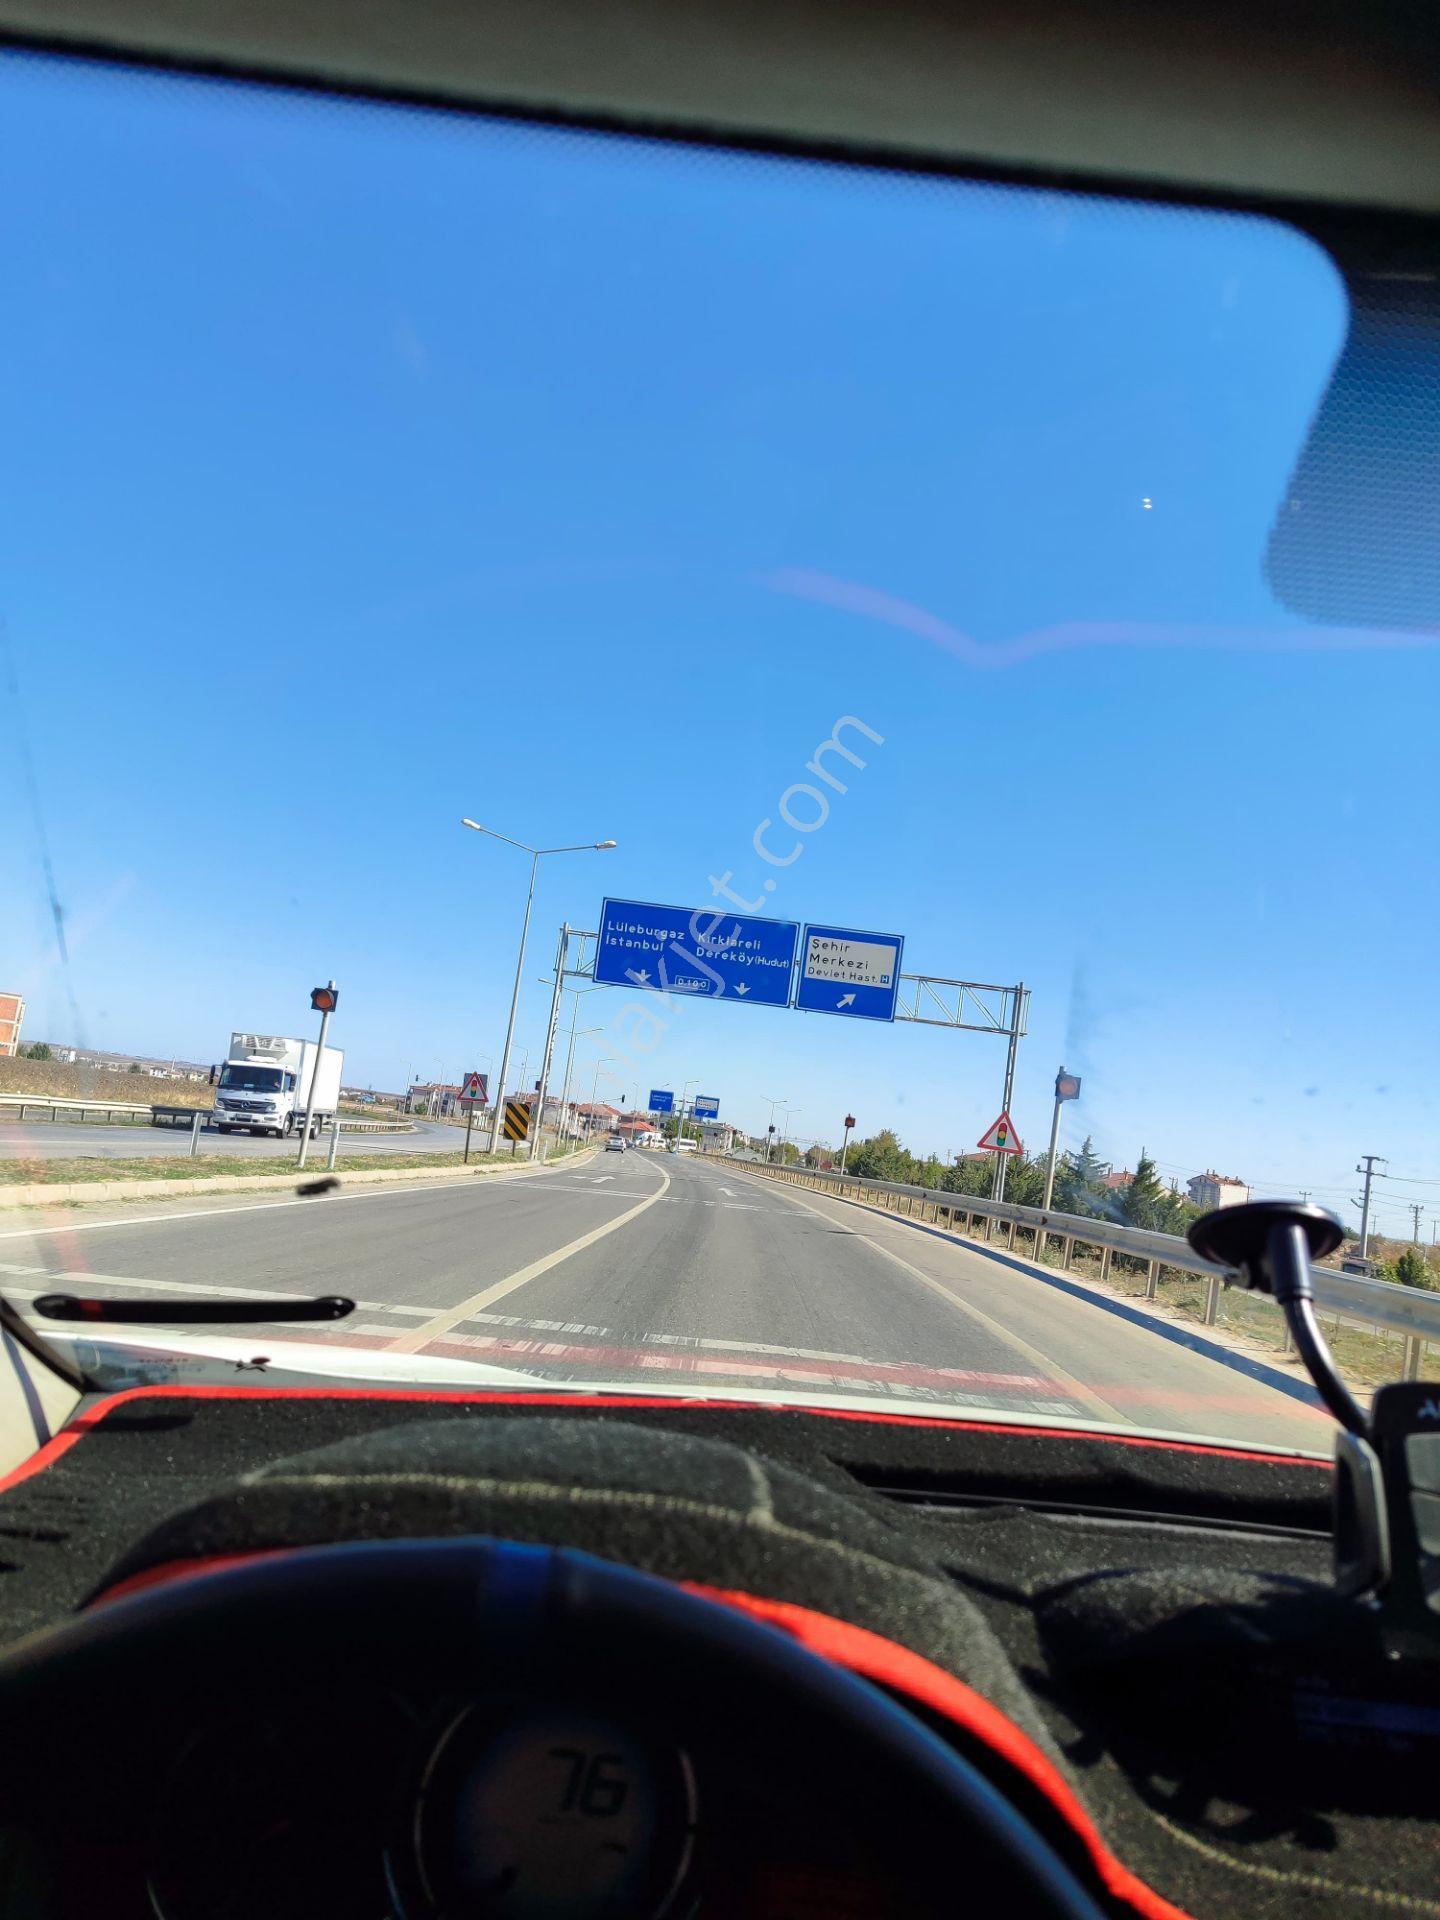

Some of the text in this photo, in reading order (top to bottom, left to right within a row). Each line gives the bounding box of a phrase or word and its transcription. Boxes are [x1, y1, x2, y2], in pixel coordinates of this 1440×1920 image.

[607, 920, 685, 941] Lüleburgaz
[605, 932, 664, 952] İstanbul
[812, 938, 850, 953] Şehir
[809, 953, 869, 970] Merkezi
[808, 967, 846, 979] Devlet
[548, 1745, 628, 1817] 76
